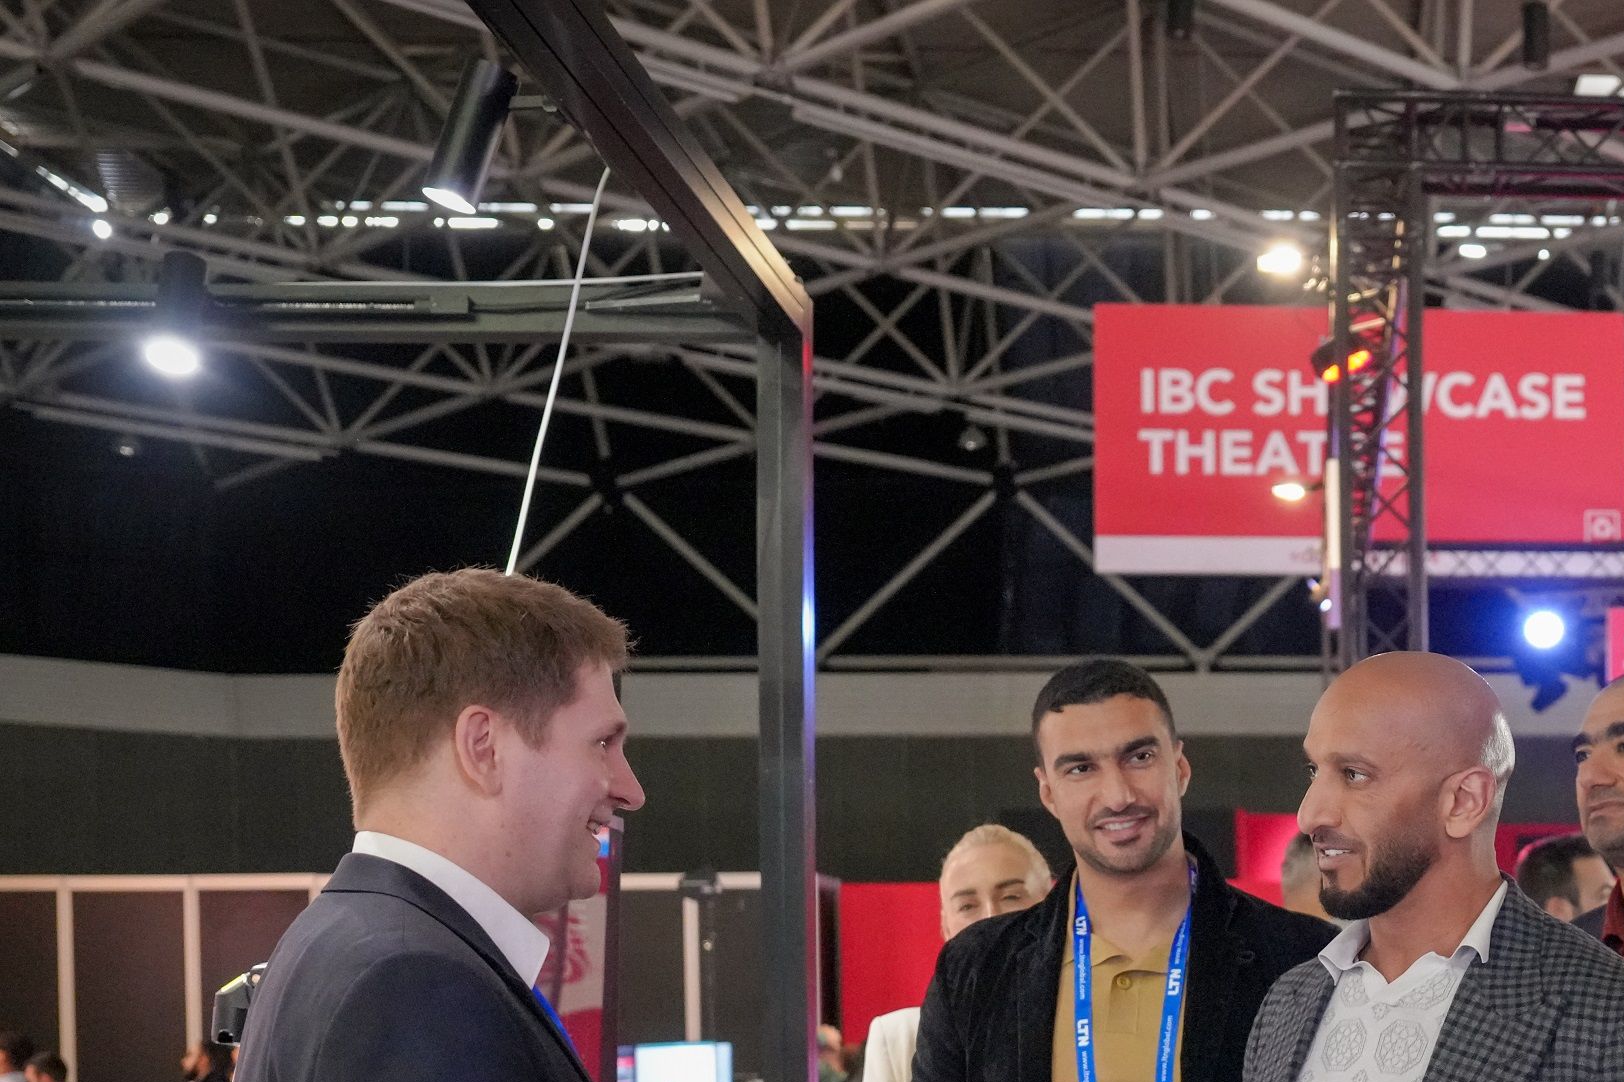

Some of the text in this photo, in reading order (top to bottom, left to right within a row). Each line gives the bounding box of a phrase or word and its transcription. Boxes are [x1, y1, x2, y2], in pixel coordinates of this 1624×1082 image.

[1140, 368, 1586, 421] IBC SHCASE
[1075, 915, 1088, 1001] LTN www.ltnglobal.com
[1167, 968, 1182, 996] LTN
[1077, 1018, 1091, 1048] LTN
[1161, 1015, 1174, 1082] www.ltnglobal.com
